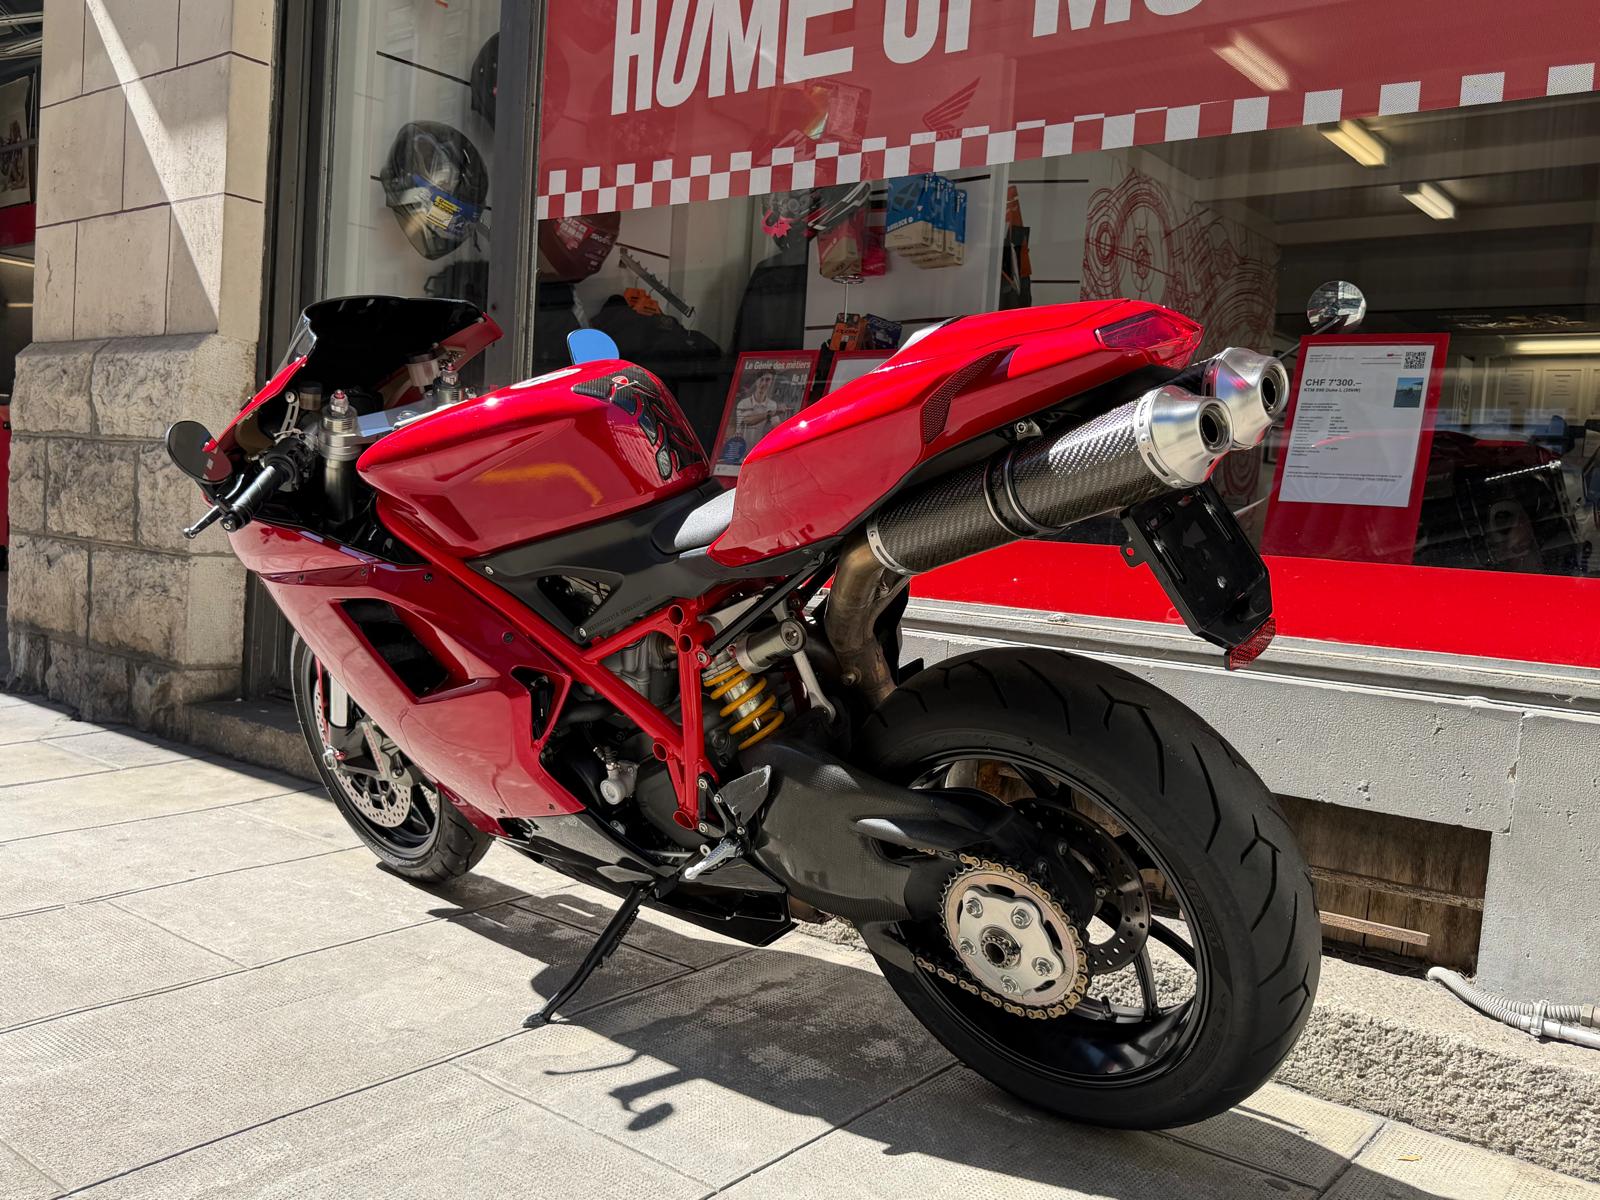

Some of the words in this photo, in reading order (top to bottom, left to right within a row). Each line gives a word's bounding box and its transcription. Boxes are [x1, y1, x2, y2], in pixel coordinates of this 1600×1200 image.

[745, 361, 754, 370] Le
[773, 360, 786, 370] des
[786, 359, 811, 369] métiers
[1305, 378, 1326, 387] CHF
